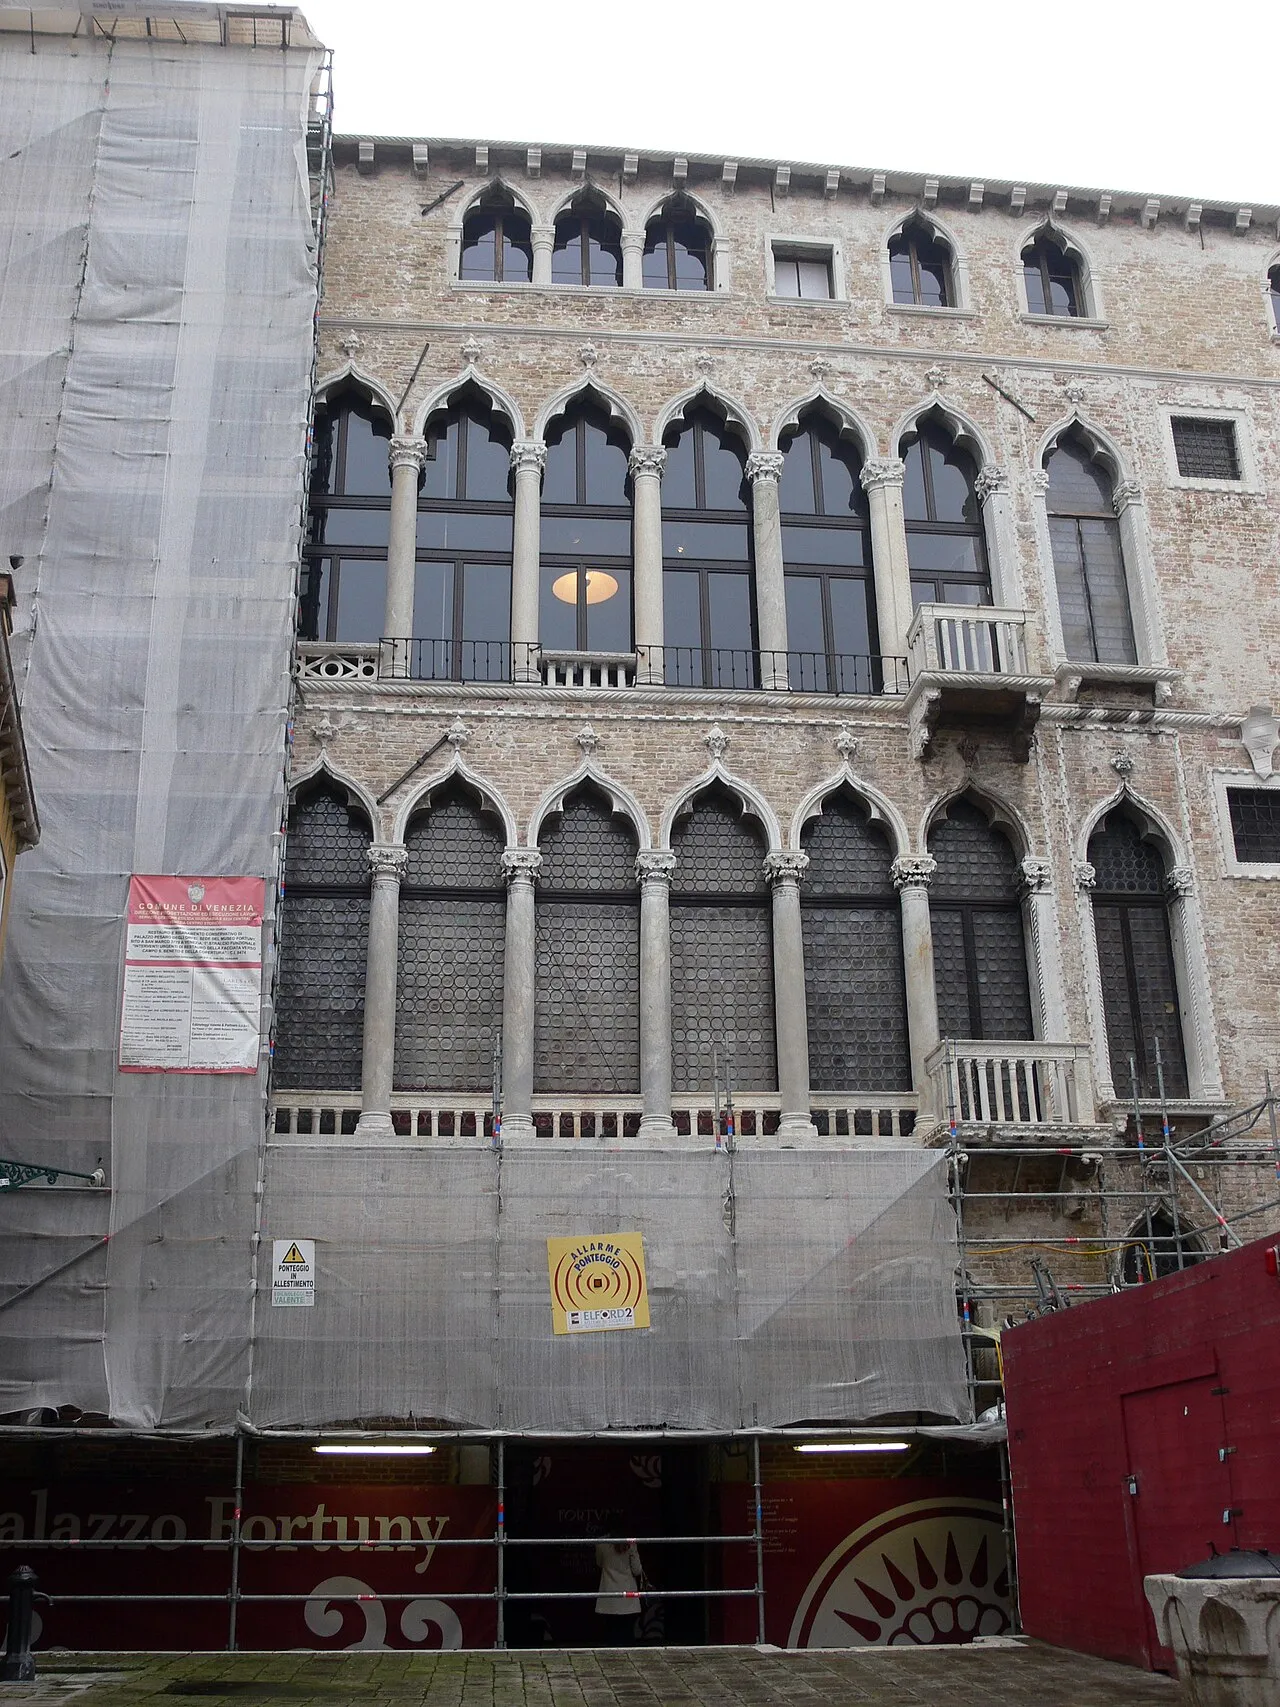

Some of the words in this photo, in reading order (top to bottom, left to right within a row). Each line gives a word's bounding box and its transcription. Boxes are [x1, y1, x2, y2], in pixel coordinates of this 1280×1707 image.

[138, 903, 185, 911] COMUNE
[205, 904, 254, 912] VENEZIA
[570, 1242, 622, 1261] ALLARME
[573, 1253, 621, 1271] PONTEGGIO
[274, 1280, 314, 1288] ALLESTIMENTO
[203, 1496, 450, 1574] Fortuny
